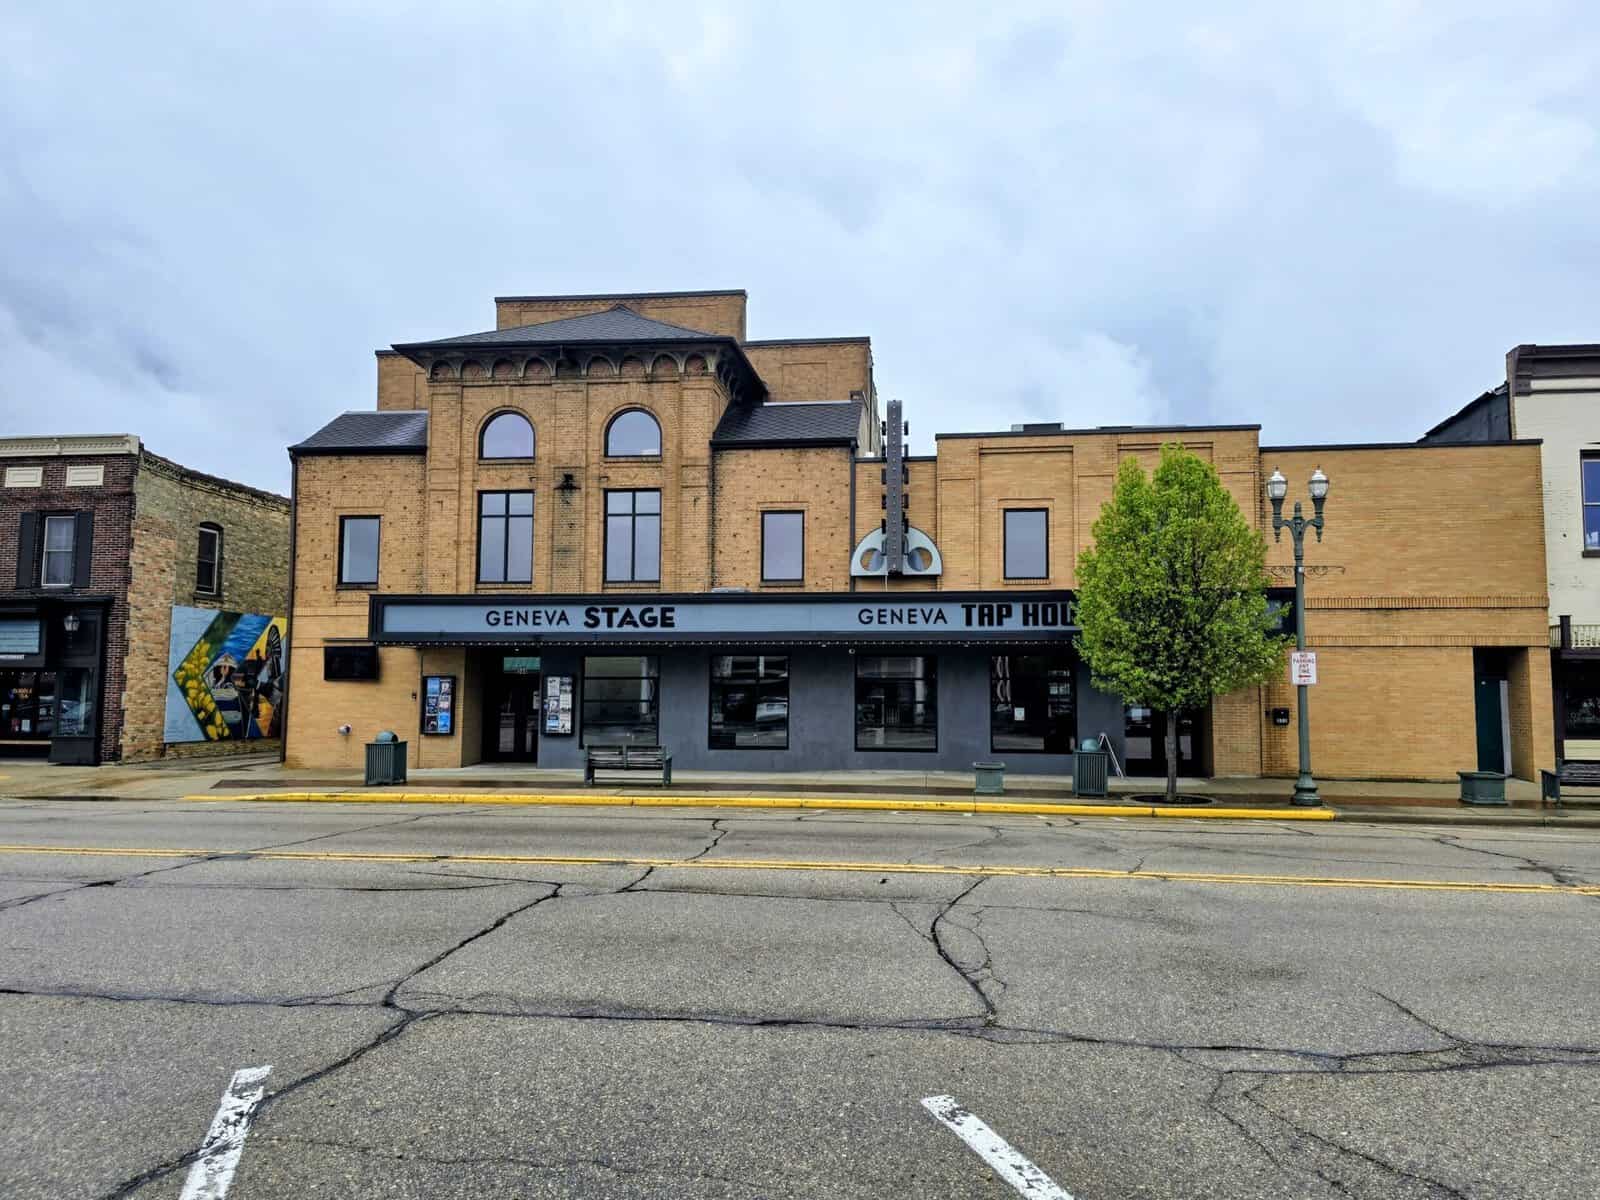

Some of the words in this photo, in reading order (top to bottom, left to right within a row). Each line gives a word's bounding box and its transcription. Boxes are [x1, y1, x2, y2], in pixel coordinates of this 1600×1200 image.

[485, 609, 570, 627] GENEVA
[583, 606, 676, 628] STAGE
[857, 607, 948, 625] GENEVA
[960, 603, 1013, 627] TAP
[1021, 603, 1076, 627] HOU
